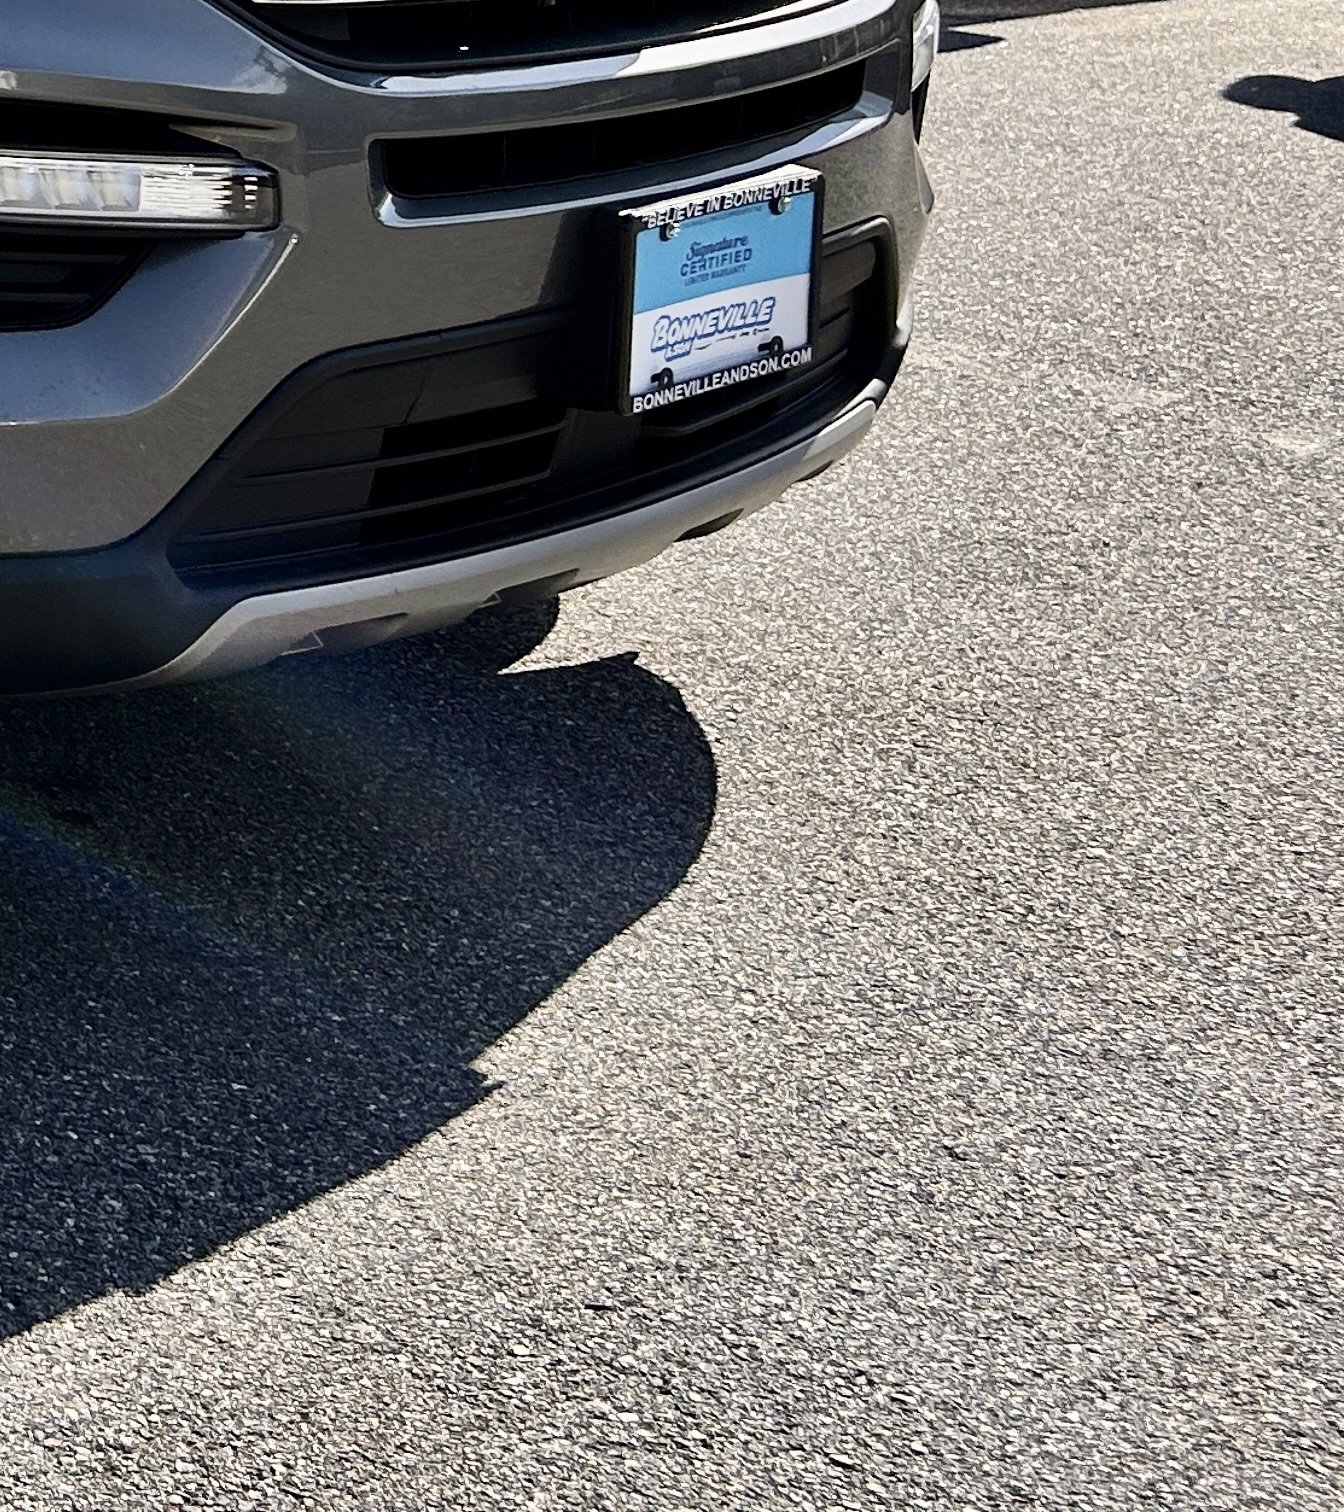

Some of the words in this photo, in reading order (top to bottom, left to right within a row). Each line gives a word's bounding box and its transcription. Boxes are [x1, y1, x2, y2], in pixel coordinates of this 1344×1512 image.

[706, 197, 721, 213] IN
[680, 248, 753, 277] CERTIFIED
[685, 234, 749, 262] Signature
[650, 296, 776, 353] BONNEVILLE
[633, 347, 813, 413] BONNEVILLEANDSON.COM
